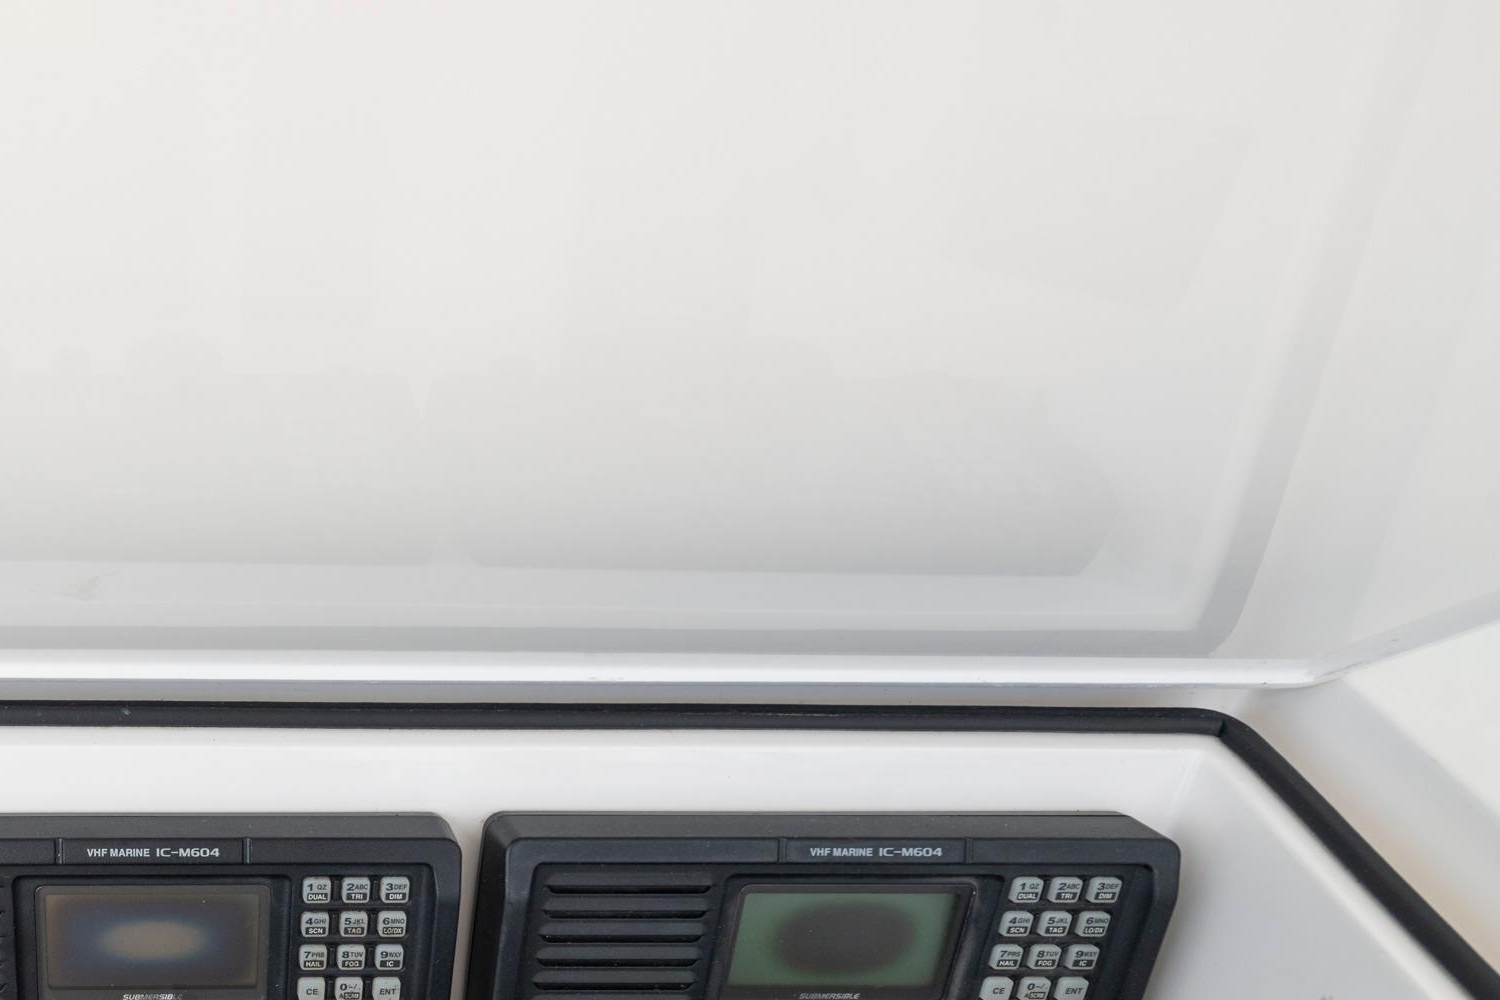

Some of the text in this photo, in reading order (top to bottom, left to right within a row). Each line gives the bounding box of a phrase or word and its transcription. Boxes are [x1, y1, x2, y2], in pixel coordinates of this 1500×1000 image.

[86, 847, 220, 858] VHF MARINE IC-M604
[810, 847, 942, 857] VHF MARINE IC-M604
